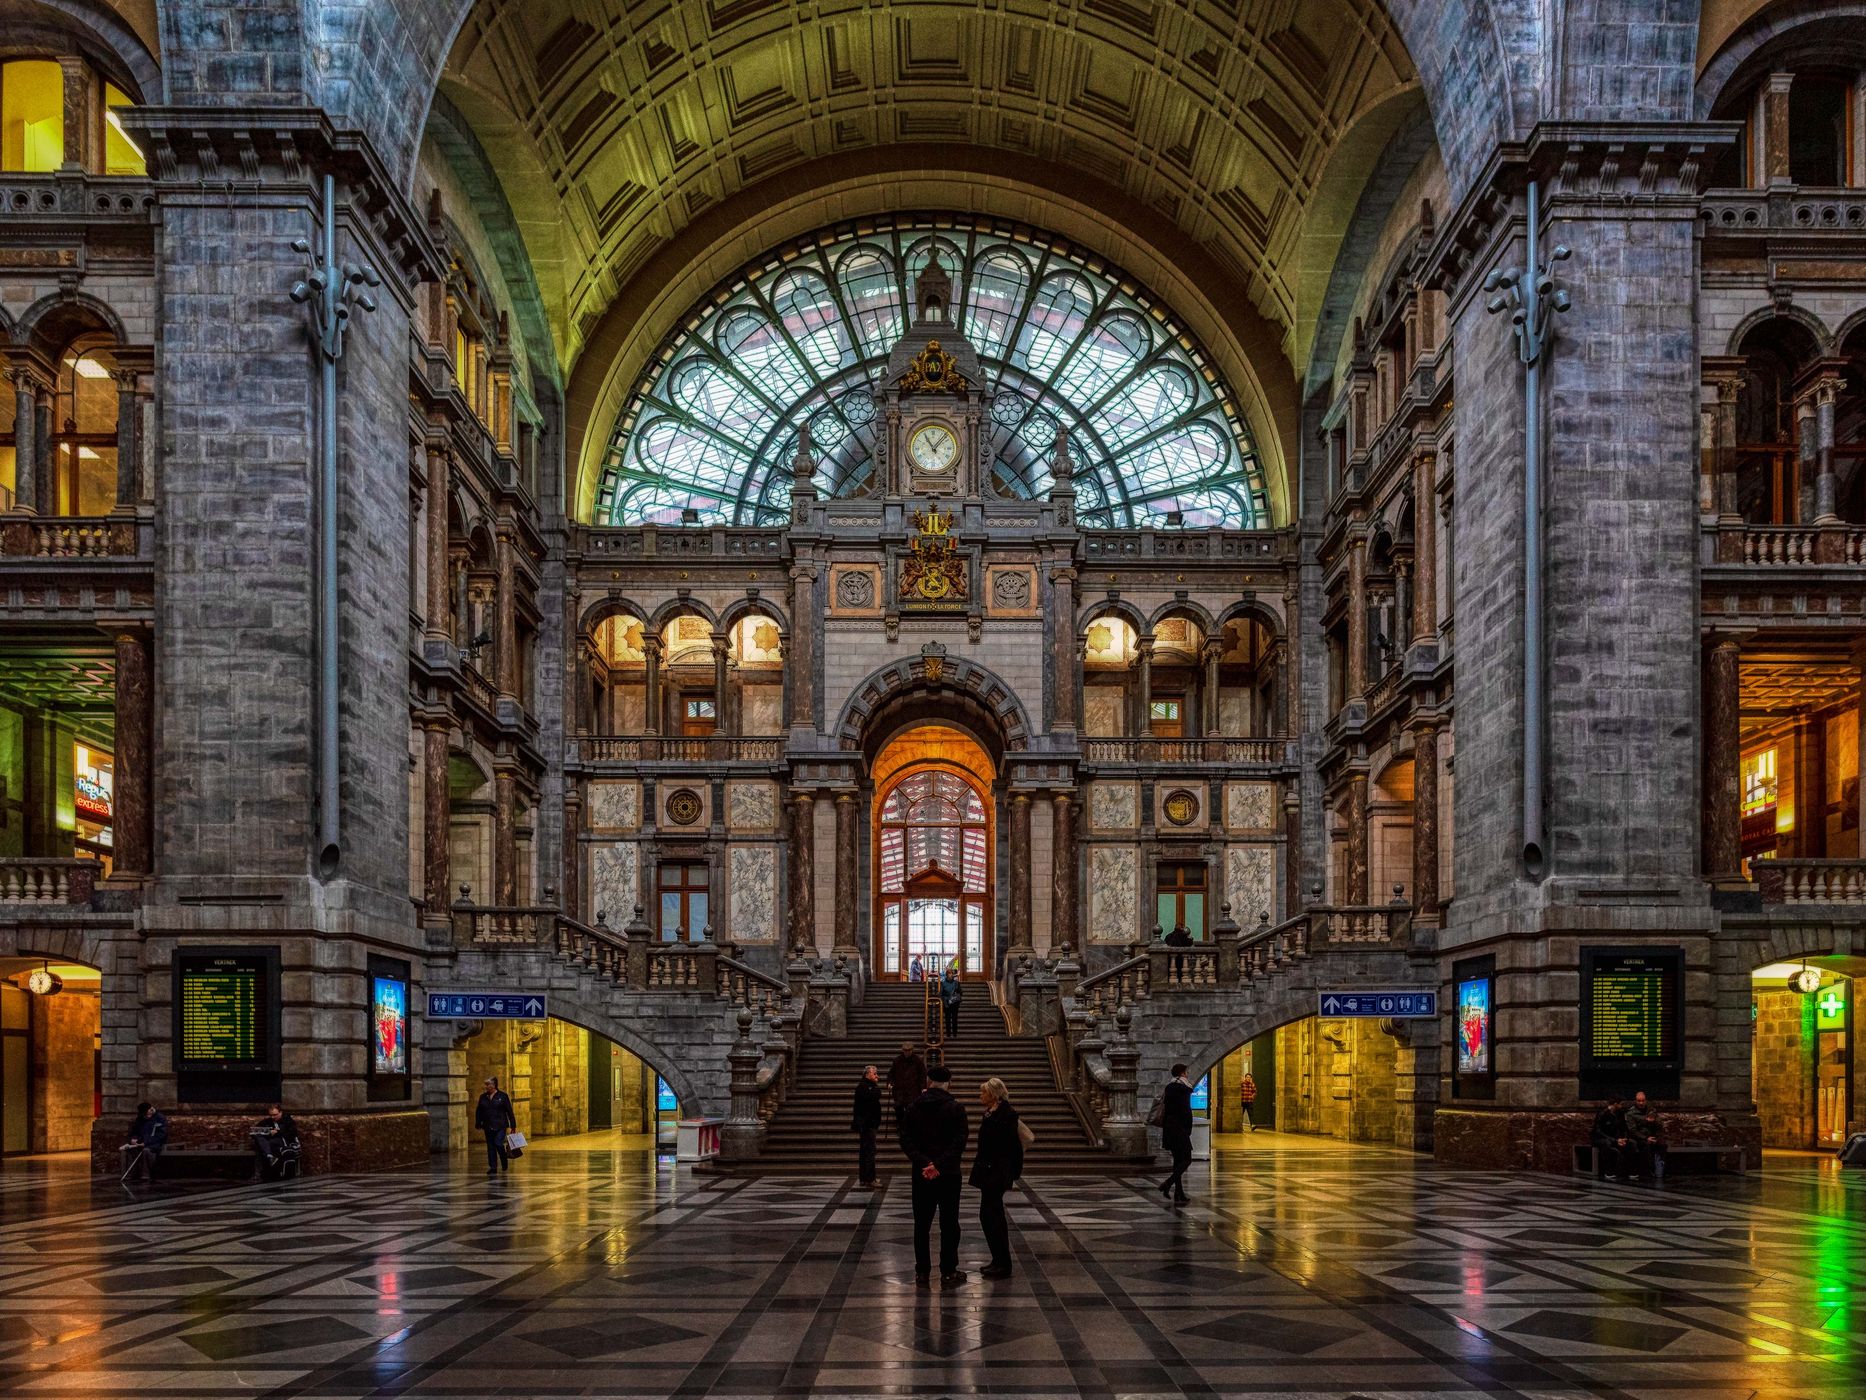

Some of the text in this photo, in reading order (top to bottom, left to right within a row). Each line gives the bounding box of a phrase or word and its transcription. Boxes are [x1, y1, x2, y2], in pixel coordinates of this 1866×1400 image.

[925, 361, 942, 373] PAX
[78, 777, 109, 801] Regus
[77, 797, 108, 814] express
